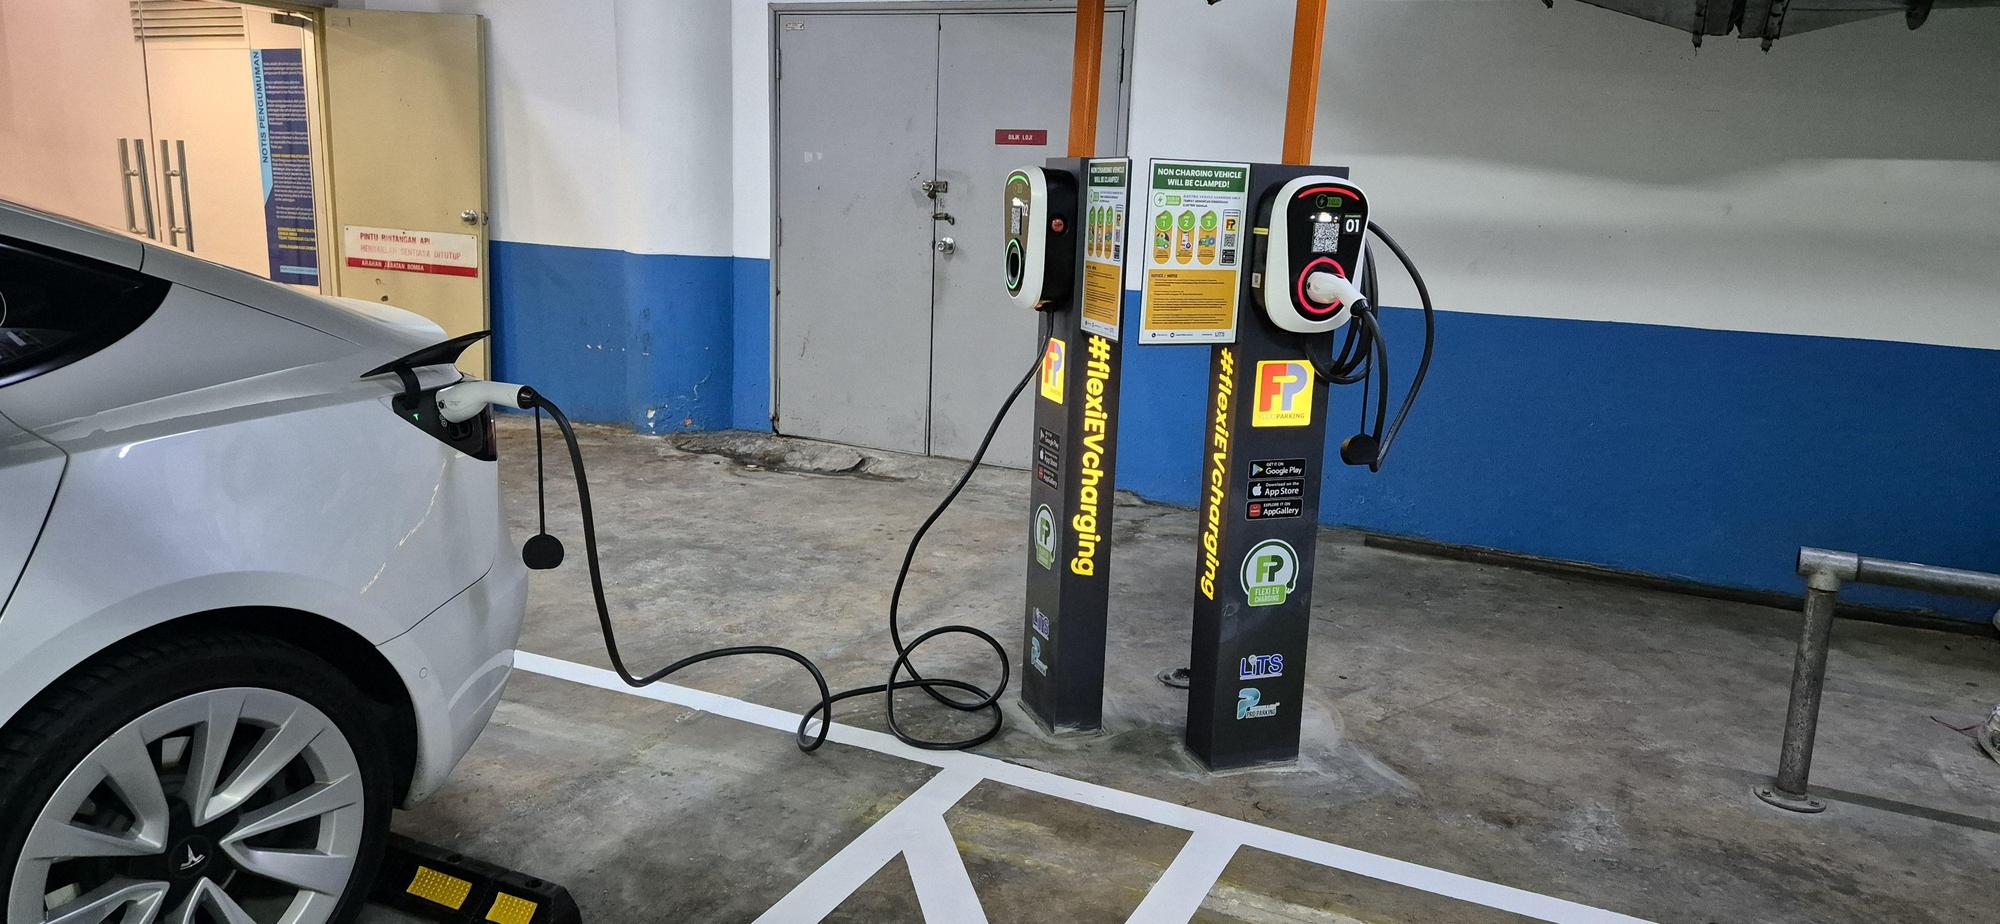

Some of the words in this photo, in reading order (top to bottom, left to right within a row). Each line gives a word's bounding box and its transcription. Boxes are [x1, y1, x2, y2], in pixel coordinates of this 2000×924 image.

[254, 52, 266, 128] PENGUMUMAN
[260, 132, 268, 163] NOTIS
[1175, 169, 1213, 177] CHARGING
[1194, 180, 1230, 188] CLAMPED!
[1346, 218, 1360, 232] 01
[1259, 363, 1308, 412] FP
[1070, 335, 1110, 576] #flexiEVcharging
[1201, 348, 1234, 600] #flexiEVcharging
[1266, 467, 1288, 476] Google
[1289, 466, 1302, 474] Play
[1265, 488, 1279, 497] App
[1263, 507, 1299, 516] AppGallery
[1256, 555, 1284, 583] FP
